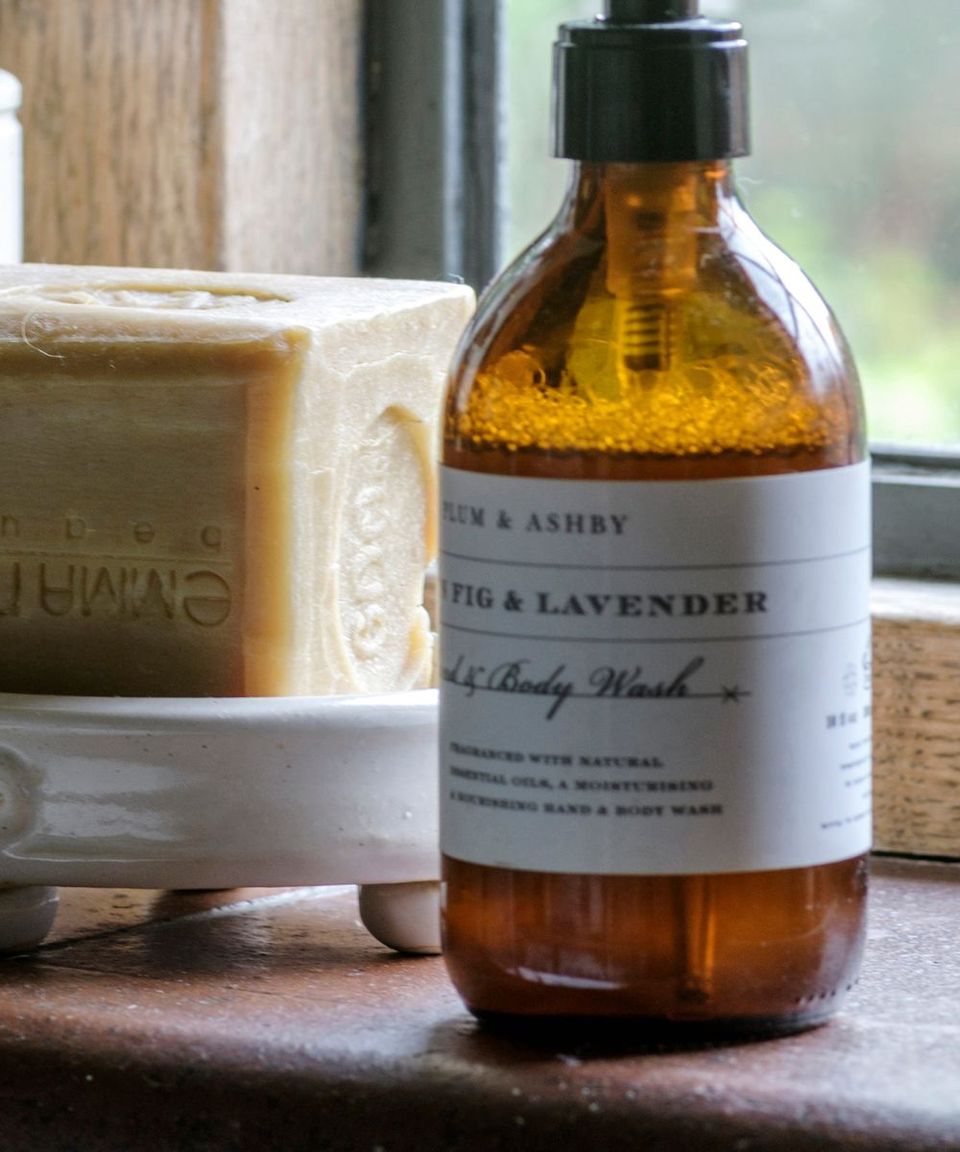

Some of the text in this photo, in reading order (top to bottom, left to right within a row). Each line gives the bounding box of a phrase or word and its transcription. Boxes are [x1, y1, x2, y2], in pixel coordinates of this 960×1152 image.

[496, 510, 513, 530] &
[525, 512, 629, 536] ASHBY
[451, 581, 494, 609] FIG
[503, 589, 524, 612] &
[538, 590, 769, 617] LAVENDER
[487, 657, 575, 721] Body
[588, 655, 705, 699] Wash
[529, 753, 573, 766] WITH
[544, 802, 592, 815] HAND
[616, 804, 664, 817] BODY
[670, 803, 724, 817] WASH
